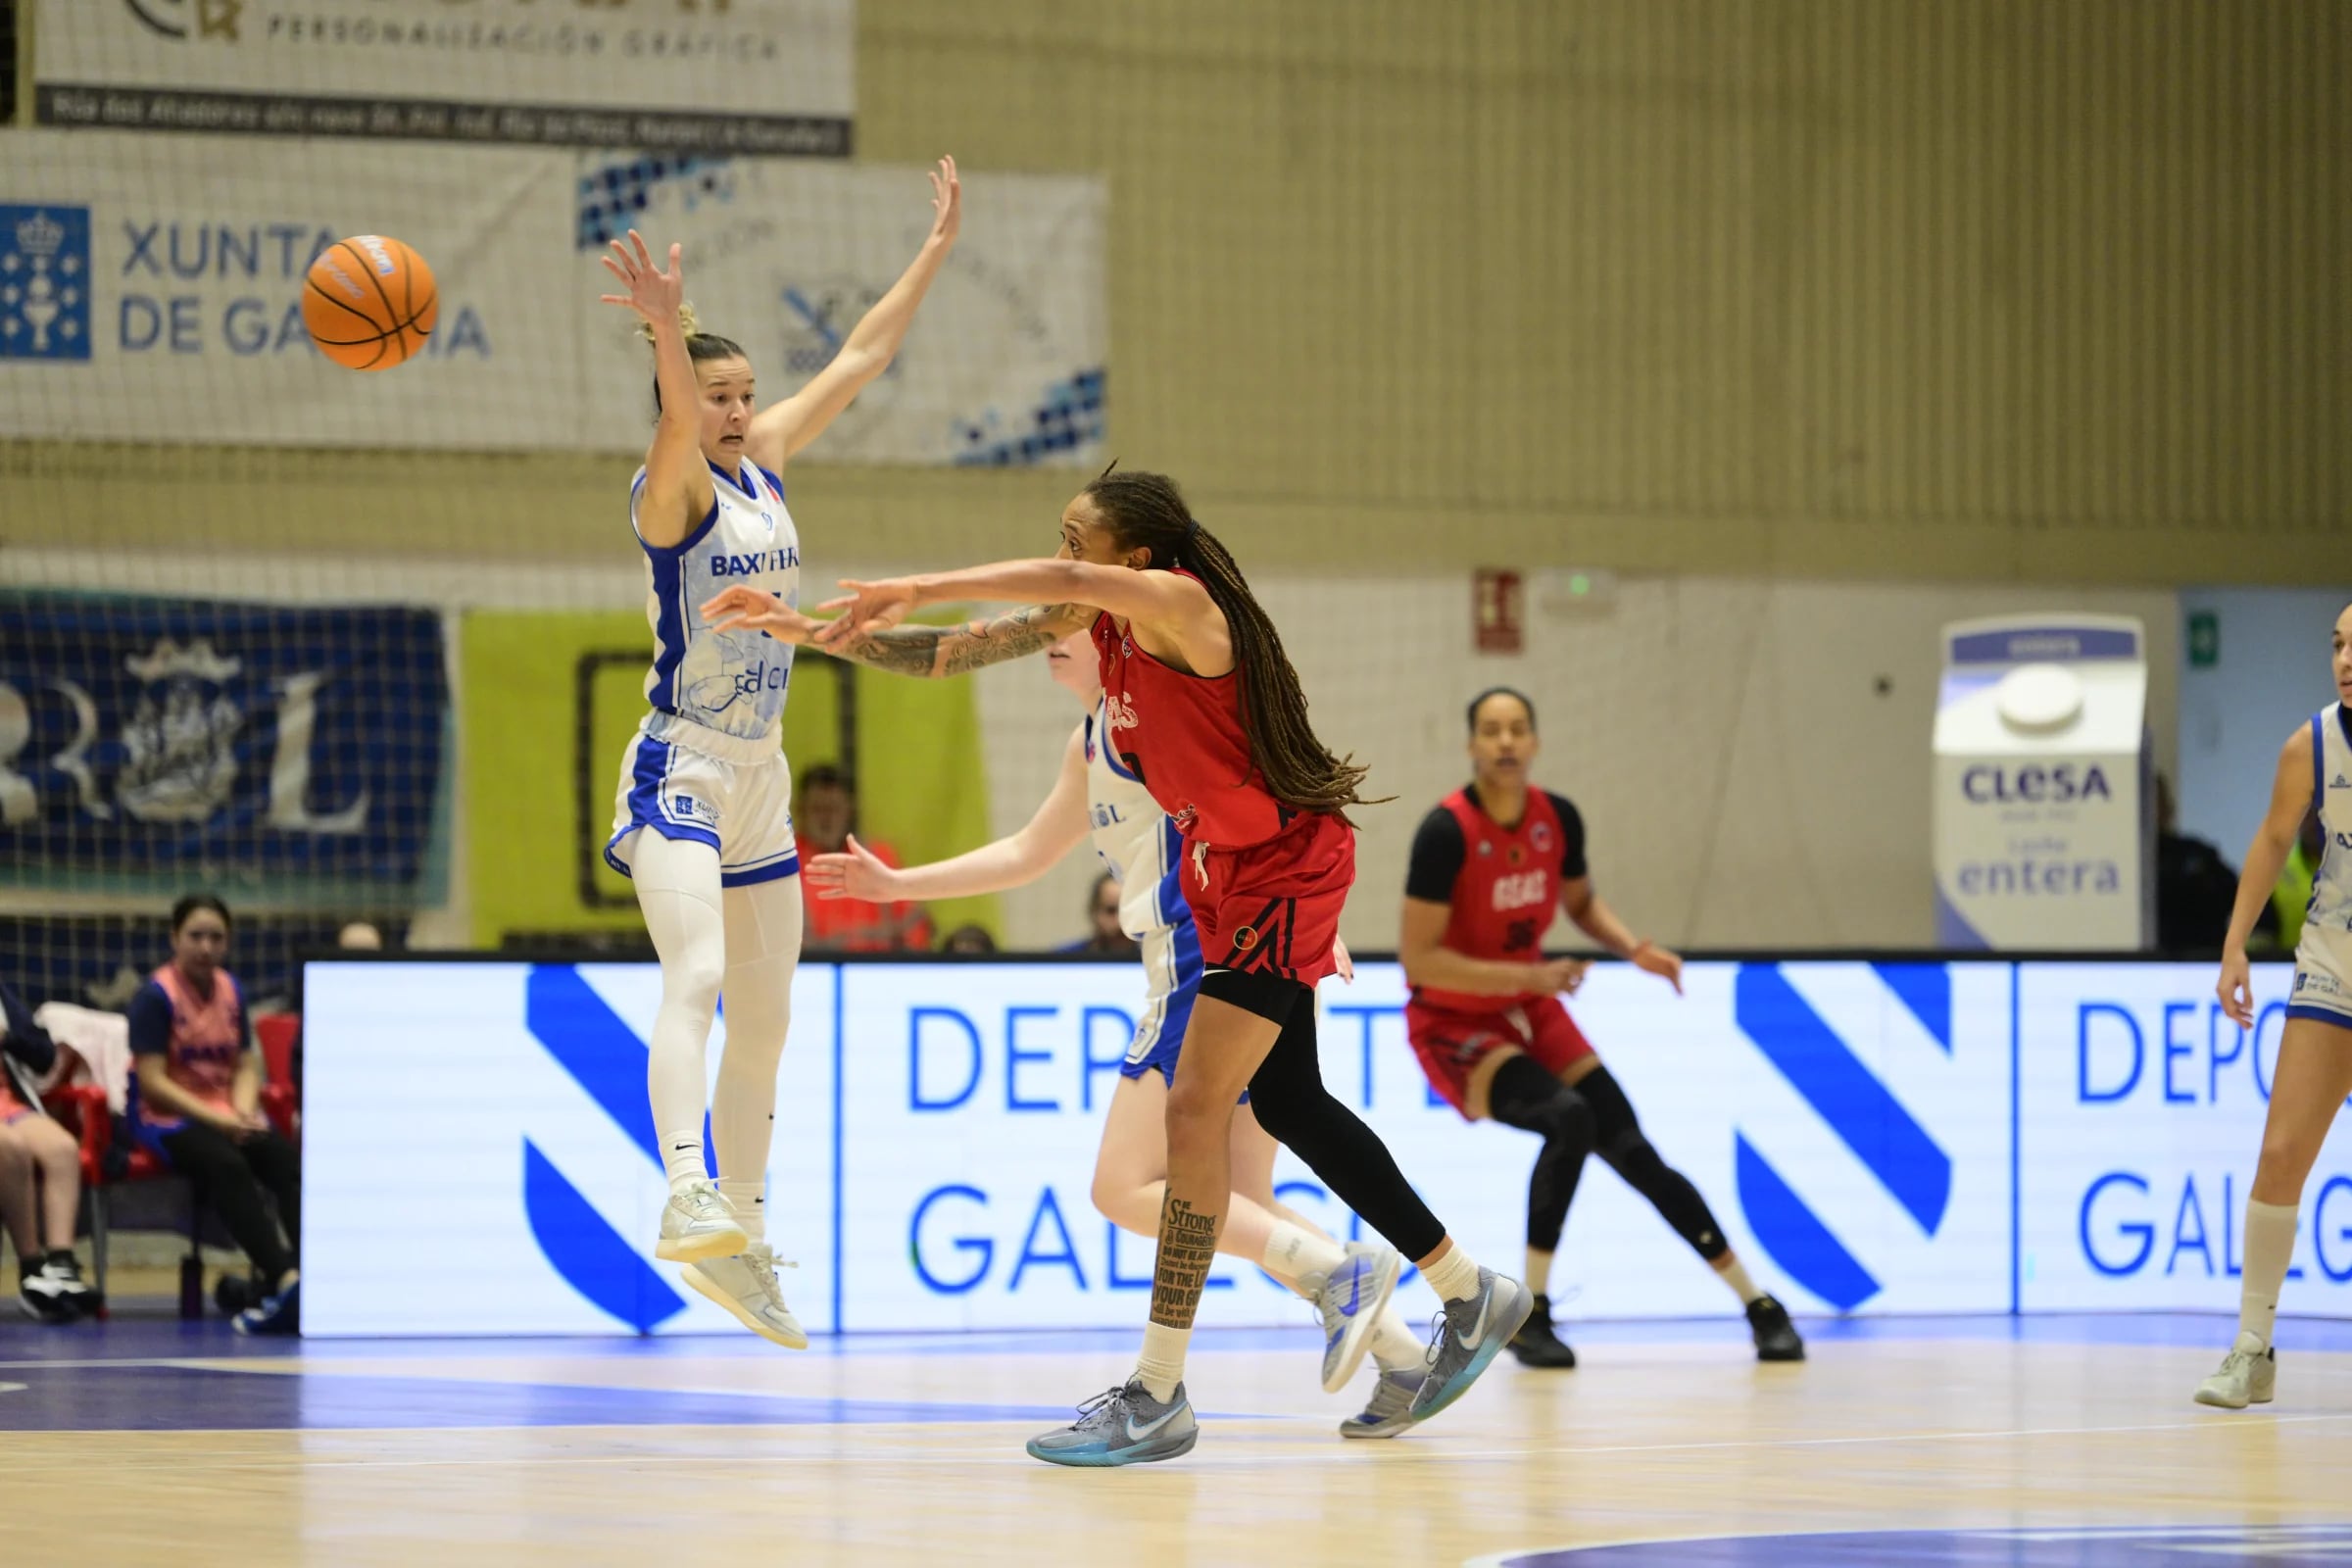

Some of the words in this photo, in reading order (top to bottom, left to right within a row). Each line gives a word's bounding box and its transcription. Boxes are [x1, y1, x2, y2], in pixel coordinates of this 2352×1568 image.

[120, 298, 203, 353] DE
[223, 299, 492, 358] GAIA
[1958, 858, 2121, 895] entera
[909, 1006, 1452, 1111] DEPT
[2078, 1001, 2352, 1104] DEP
[909, 1185, 1423, 1295] GAL
[1168, 1199, 1216, 1236] Strong
[2079, 1172, 2352, 1283] GALG
[1154, 1287, 1185, 1305] YOUR
[1177, 1271, 1195, 1289] THE
